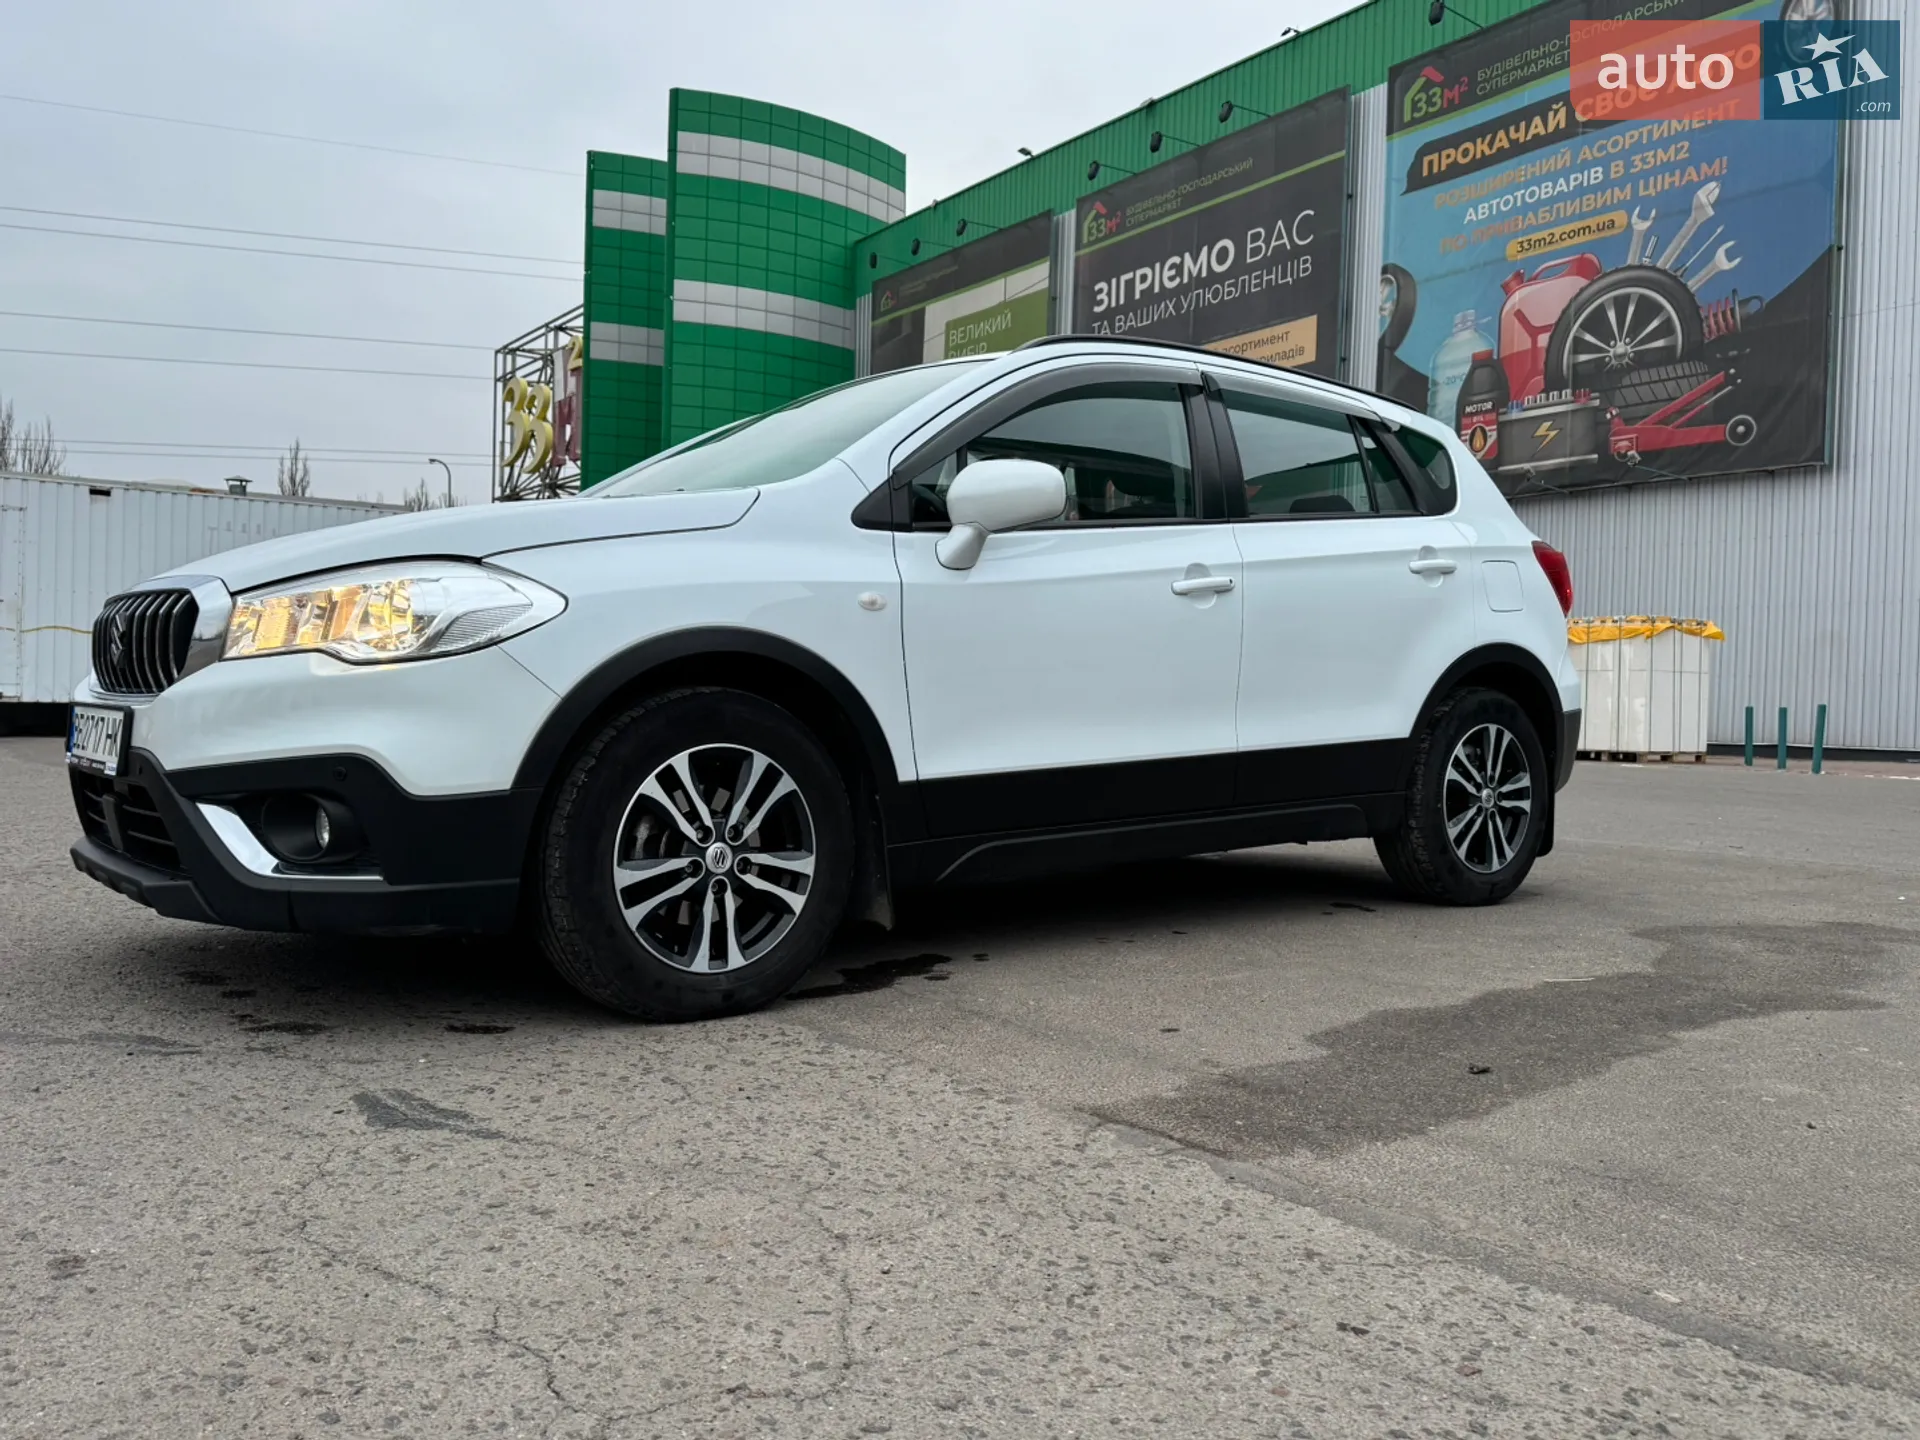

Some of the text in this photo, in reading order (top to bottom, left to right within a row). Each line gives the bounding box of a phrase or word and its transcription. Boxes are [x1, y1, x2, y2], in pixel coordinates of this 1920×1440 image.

[1476, 50, 1570, 95] СУПЕРМАРКЕТ
[1422, 102, 1567, 177] ПРОКАЧАЙ
[1435, 99, 1740, 209] РОЗШИРЕНИЙ АСОРТИМЕНТ
[1441, 156, 1728, 254] ПО ПРИВАБЛИВИМ ЦІНАМ!
[1464, 141, 1690, 224] АВТОТОВАРІВ В 33М2
[1093, 209, 1315, 313] ЗІГРІЄМО ВАС
[1516, 218, 1616, 253] 33m2.com.ua
[950, 309, 1012, 347] ВЕЛИКИЙ
[1091, 255, 1313, 335] ТА ВАШИХ УЛЮБЛЕНЦІВ
[1257, 344, 1306, 362] иладів
[1464, 401, 1493, 413] MOTOR
